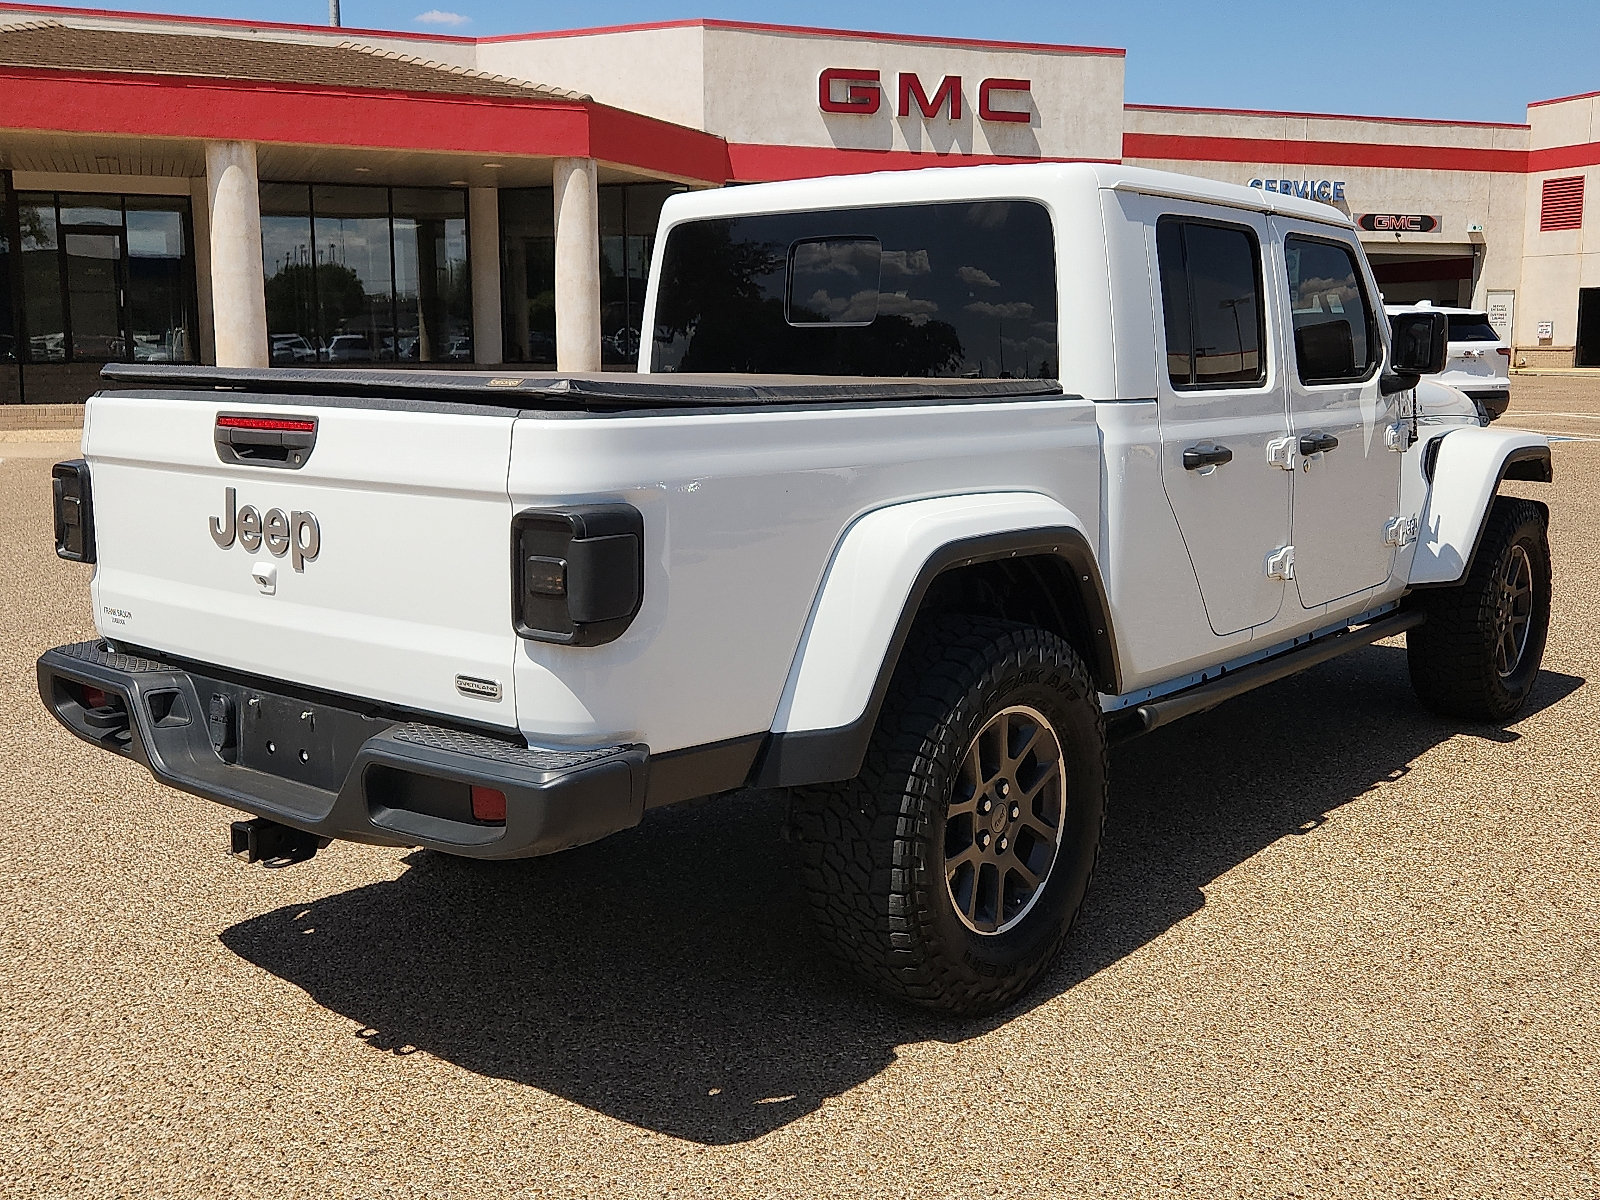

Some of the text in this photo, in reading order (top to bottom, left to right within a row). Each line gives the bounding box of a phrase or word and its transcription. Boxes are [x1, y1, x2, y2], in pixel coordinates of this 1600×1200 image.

[817, 67, 1031, 124] GMC
[1373, 215, 1422, 231] GMC
[208, 486, 321, 573] Jeep
[456, 680, 498, 692] OVERLAND
